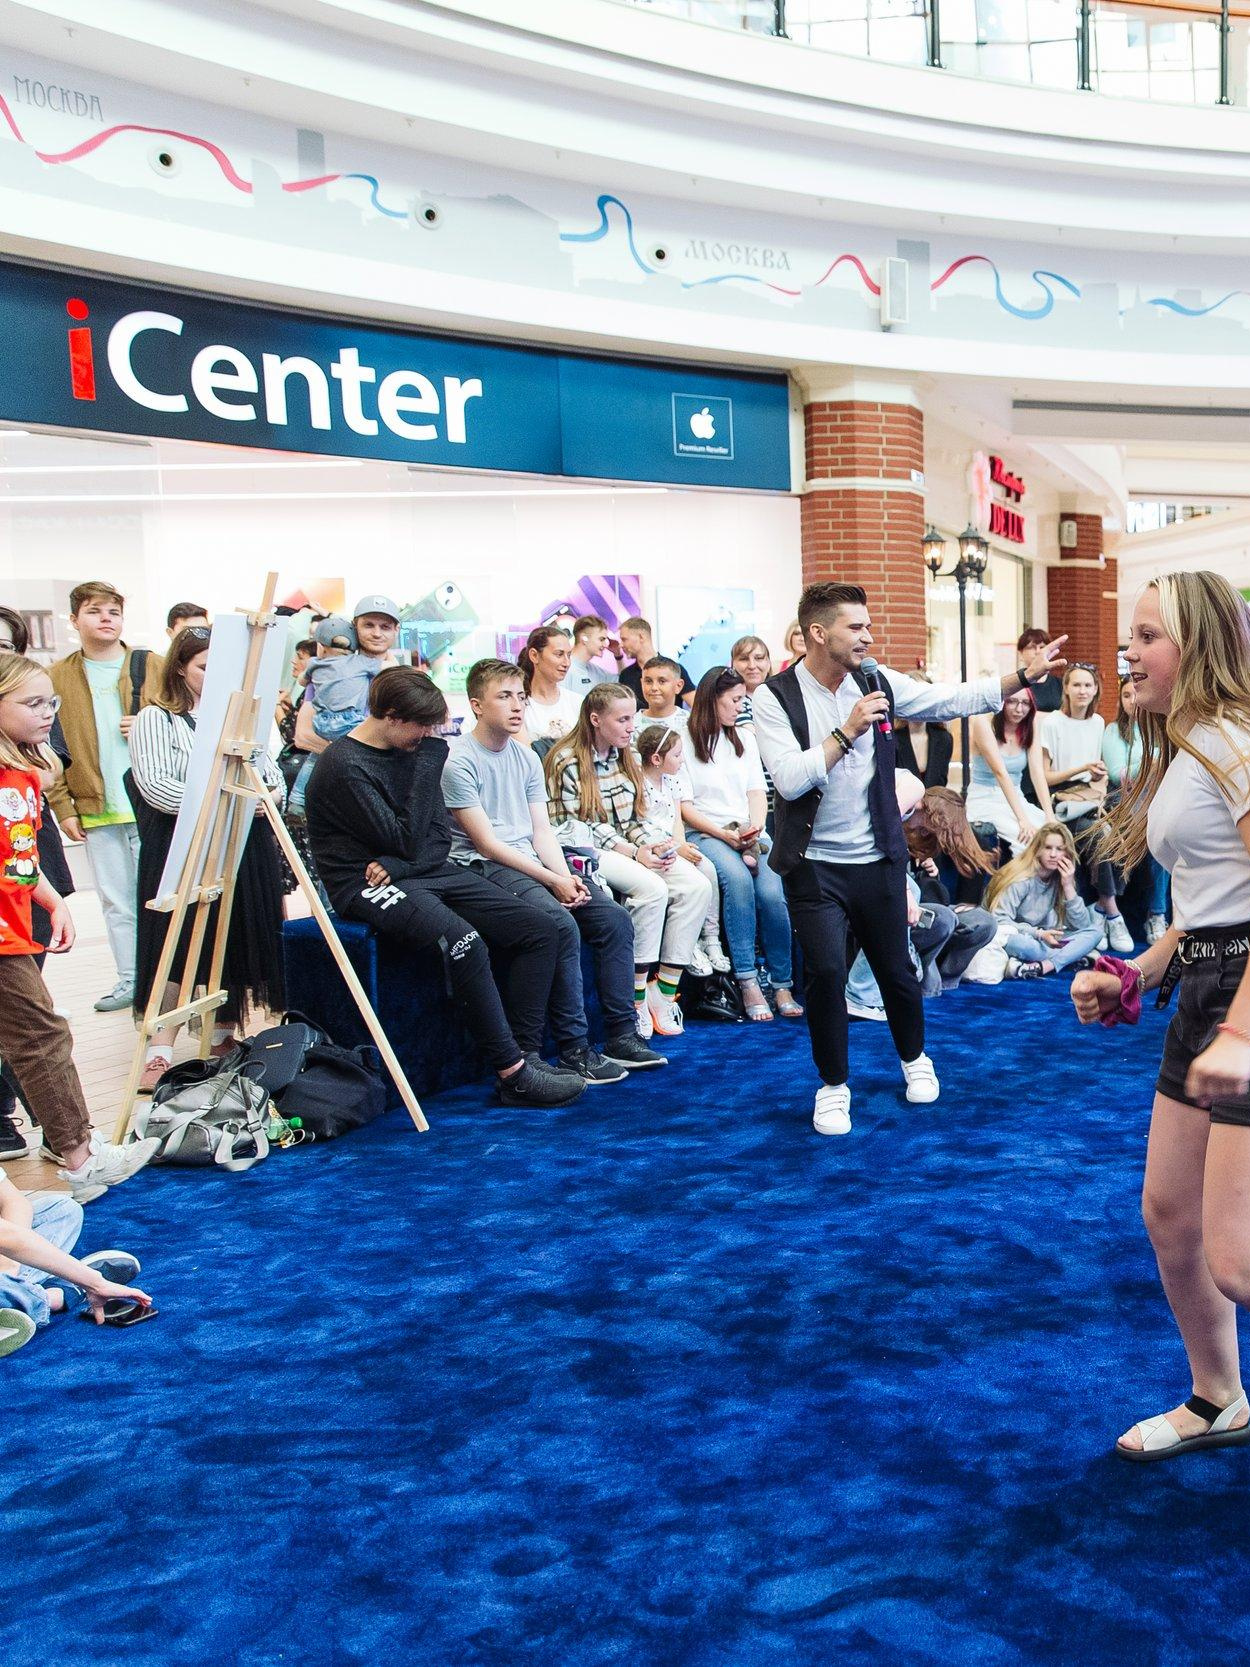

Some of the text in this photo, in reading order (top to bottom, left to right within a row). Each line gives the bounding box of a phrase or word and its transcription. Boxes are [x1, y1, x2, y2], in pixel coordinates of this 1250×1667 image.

[13, 75, 104, 122] МОСКВА
[685, 240, 790, 270] МОСКВА
[66, 298, 483, 444] iCenter
